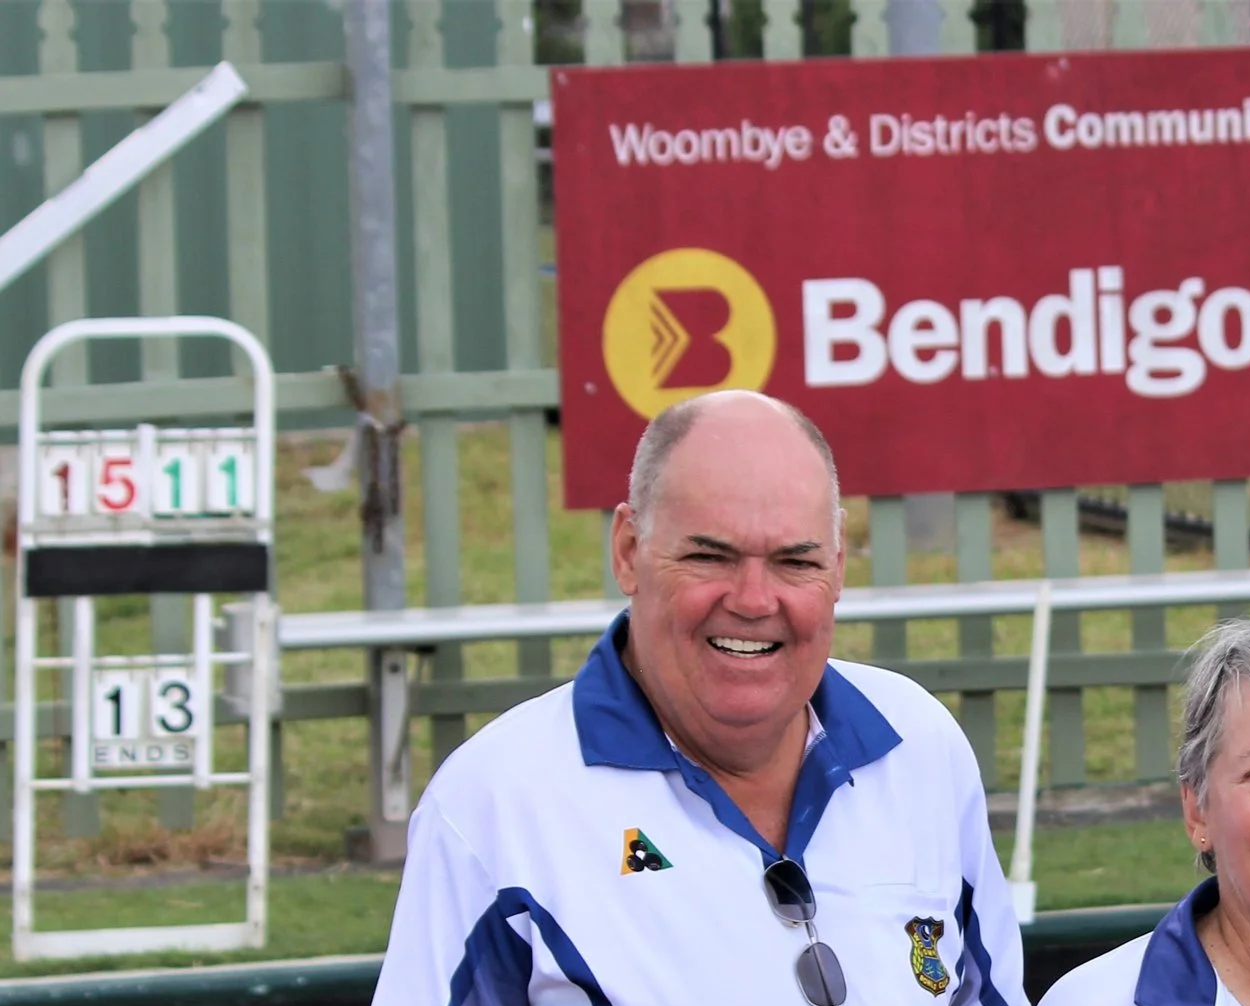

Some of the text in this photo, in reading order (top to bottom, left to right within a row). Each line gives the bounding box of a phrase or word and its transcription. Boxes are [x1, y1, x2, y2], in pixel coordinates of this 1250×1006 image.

[609, 121, 811, 169] Woombye
[823, 114, 857, 158] &
[870, 112, 1036, 156] Districts
[94, 743, 190, 763] ENDS
